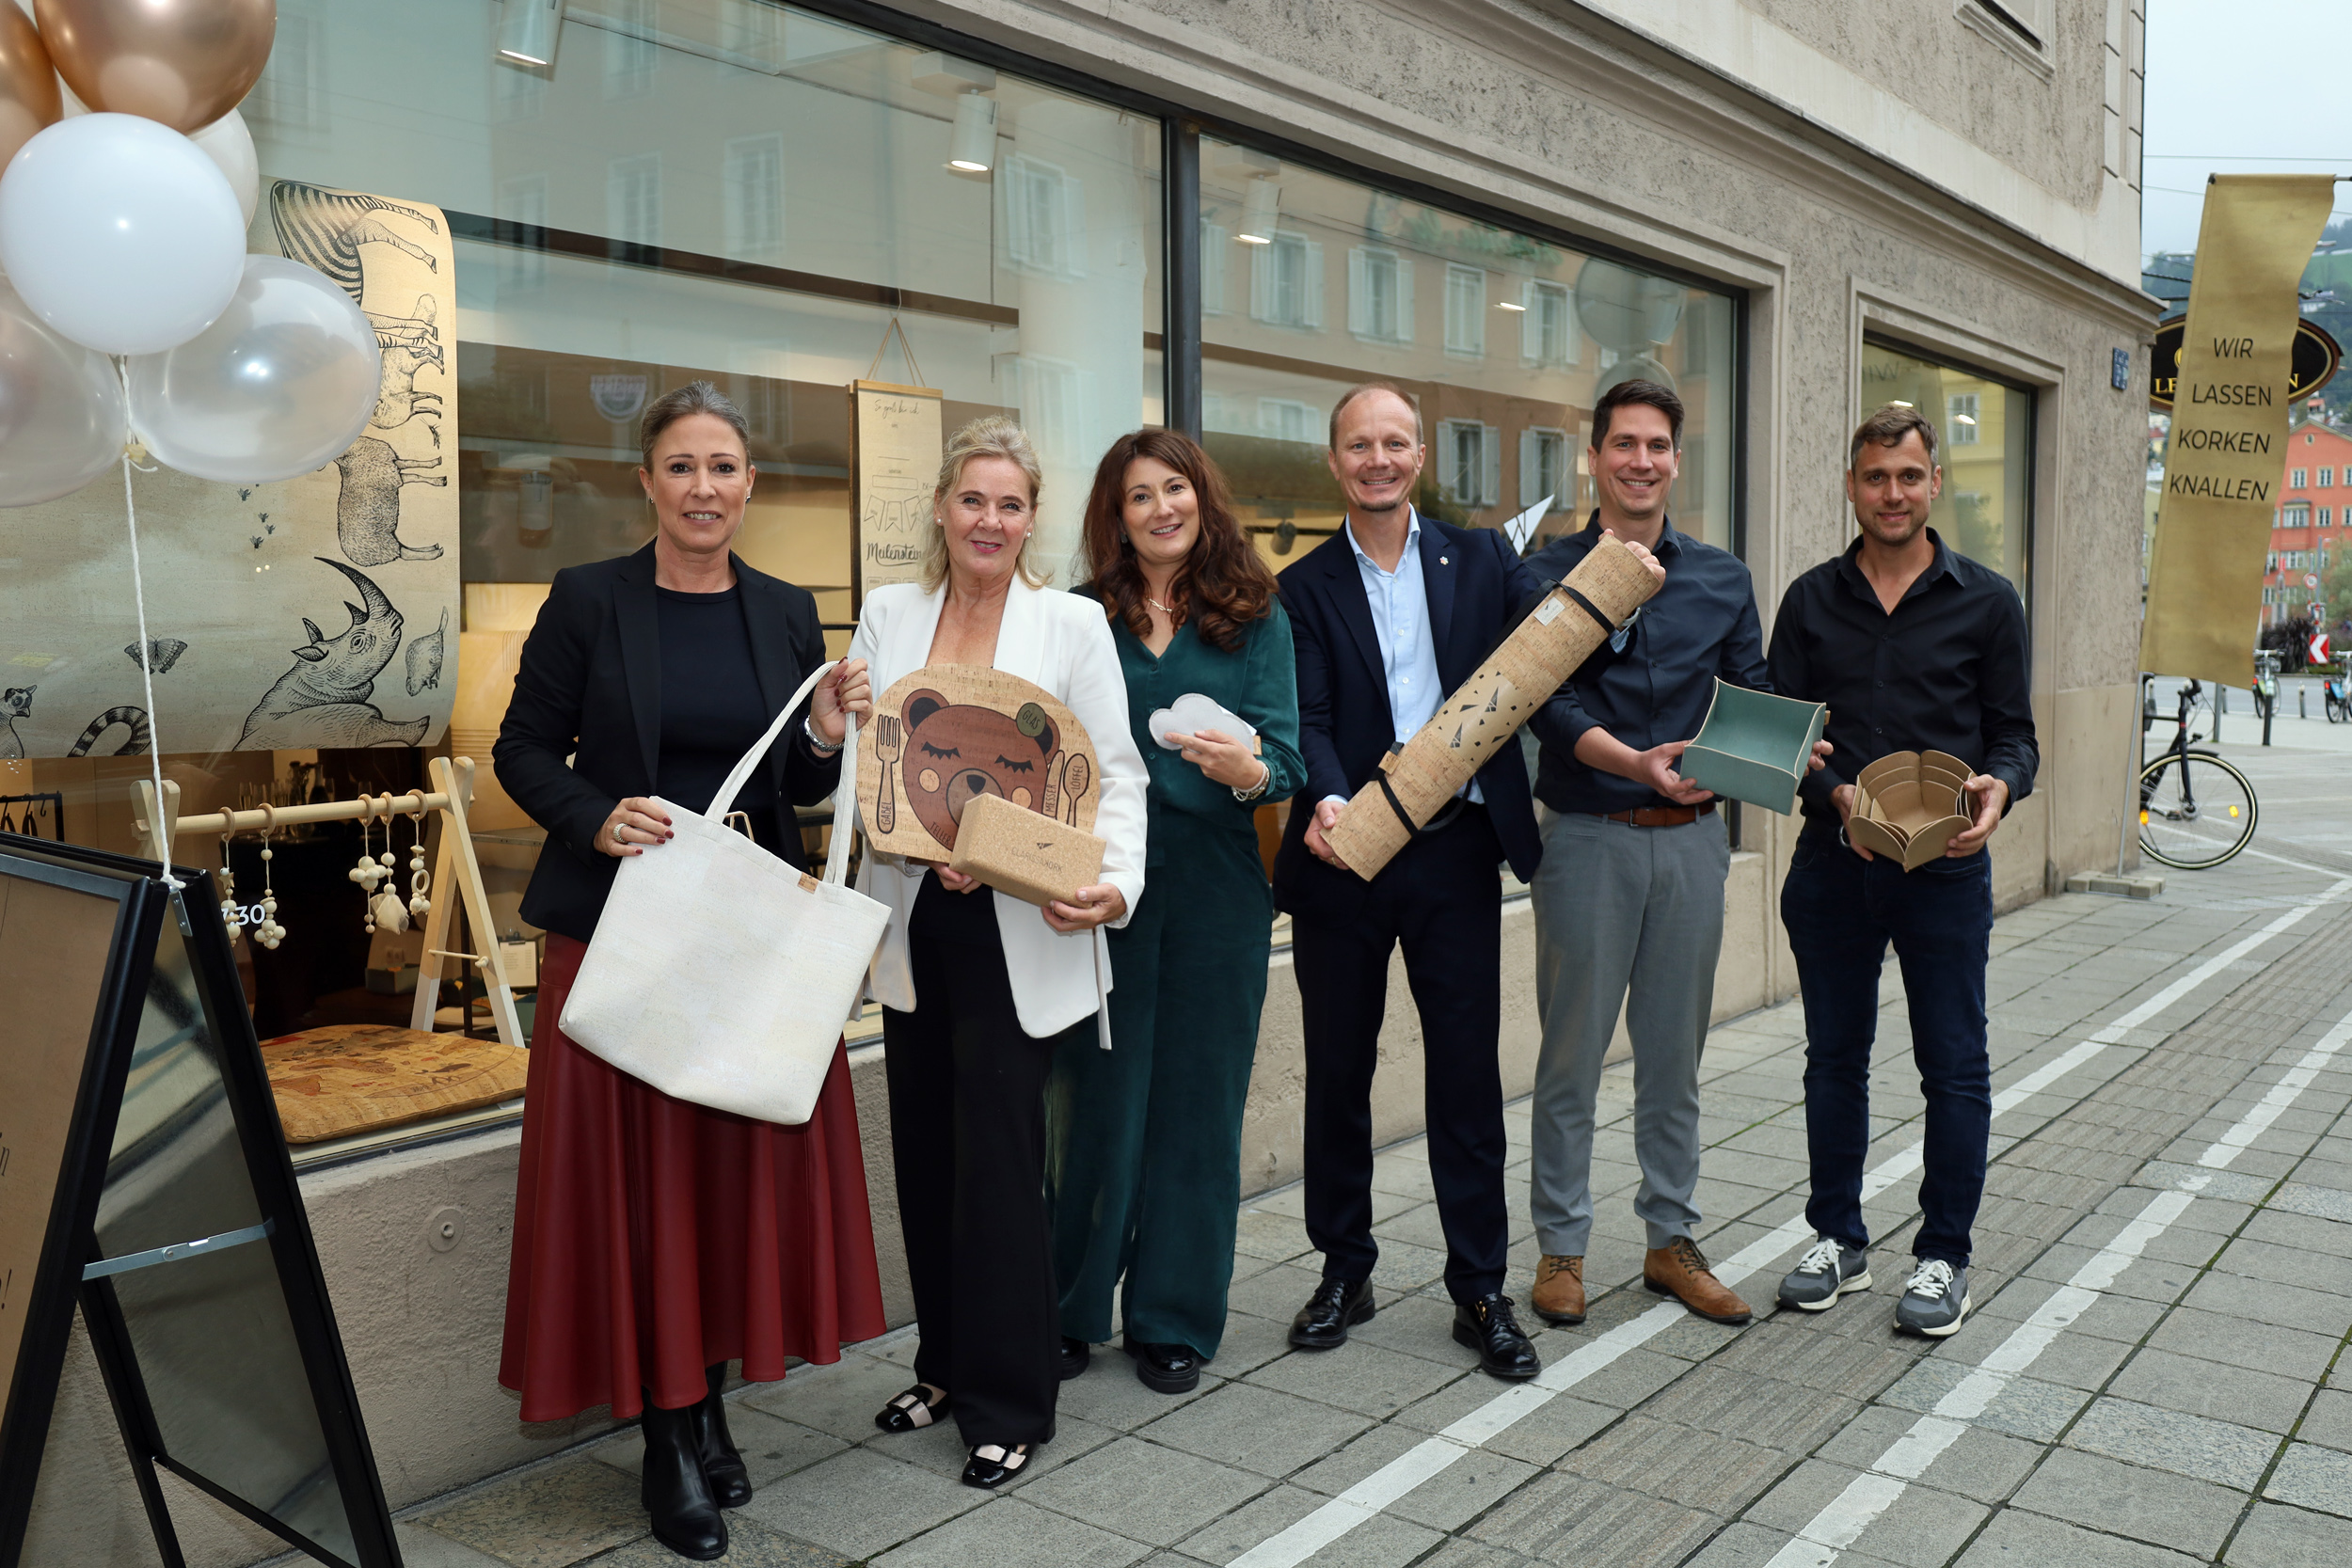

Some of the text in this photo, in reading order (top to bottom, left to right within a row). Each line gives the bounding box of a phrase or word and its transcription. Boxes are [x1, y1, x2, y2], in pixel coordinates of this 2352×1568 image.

[2214, 337, 2253, 358] WIR
[2191, 383, 2272, 406] LASSEN
[2177, 428, 2271, 454] KORKEN
[2169, 473, 2270, 501] KNALLEN
[1022, 709, 1041, 730] GLAS
[1045, 784, 1057, 813] MESSER
[881, 800, 892, 826] GABEL
[930, 821, 952, 847] TELLER
